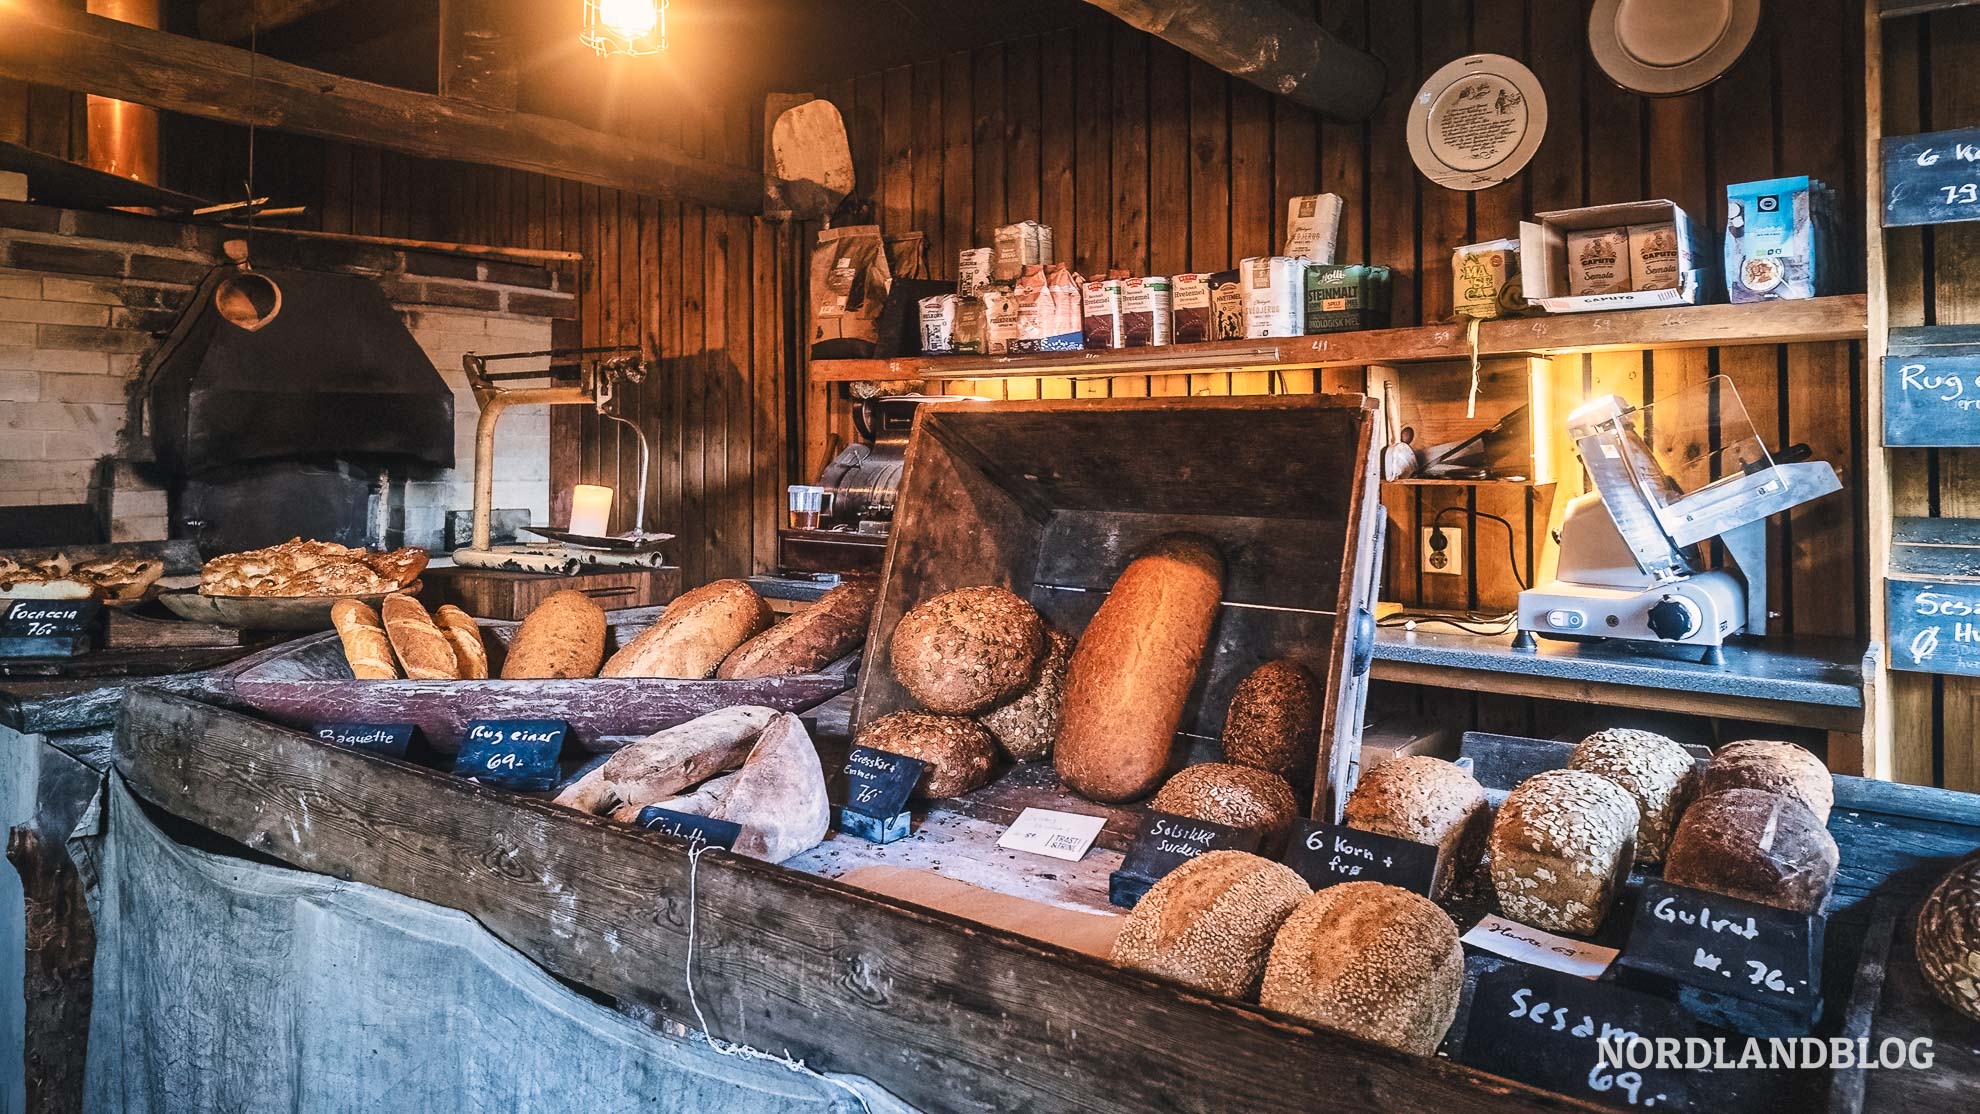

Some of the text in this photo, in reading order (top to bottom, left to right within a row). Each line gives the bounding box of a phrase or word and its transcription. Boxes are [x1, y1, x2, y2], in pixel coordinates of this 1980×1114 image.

[1917, 148, 1940, 166] 6
[1582, 258, 1616, 266] CAPUTO
[1642, 251, 1677, 260] CAPUTO
[1584, 271, 1614, 281] Semola
[1645, 265, 1676, 275] Semola
[1308, 286, 1358, 301] STEINMALT
[1584, 295, 1634, 304] CAPUTO
[1899, 364, 1963, 401] Rug
[470, 725, 561, 745] Rug einer
[1306, 830, 1324, 851] 6
[1334, 835, 1374, 861] Korn
[1508, 987, 1640, 1048] Sesam
